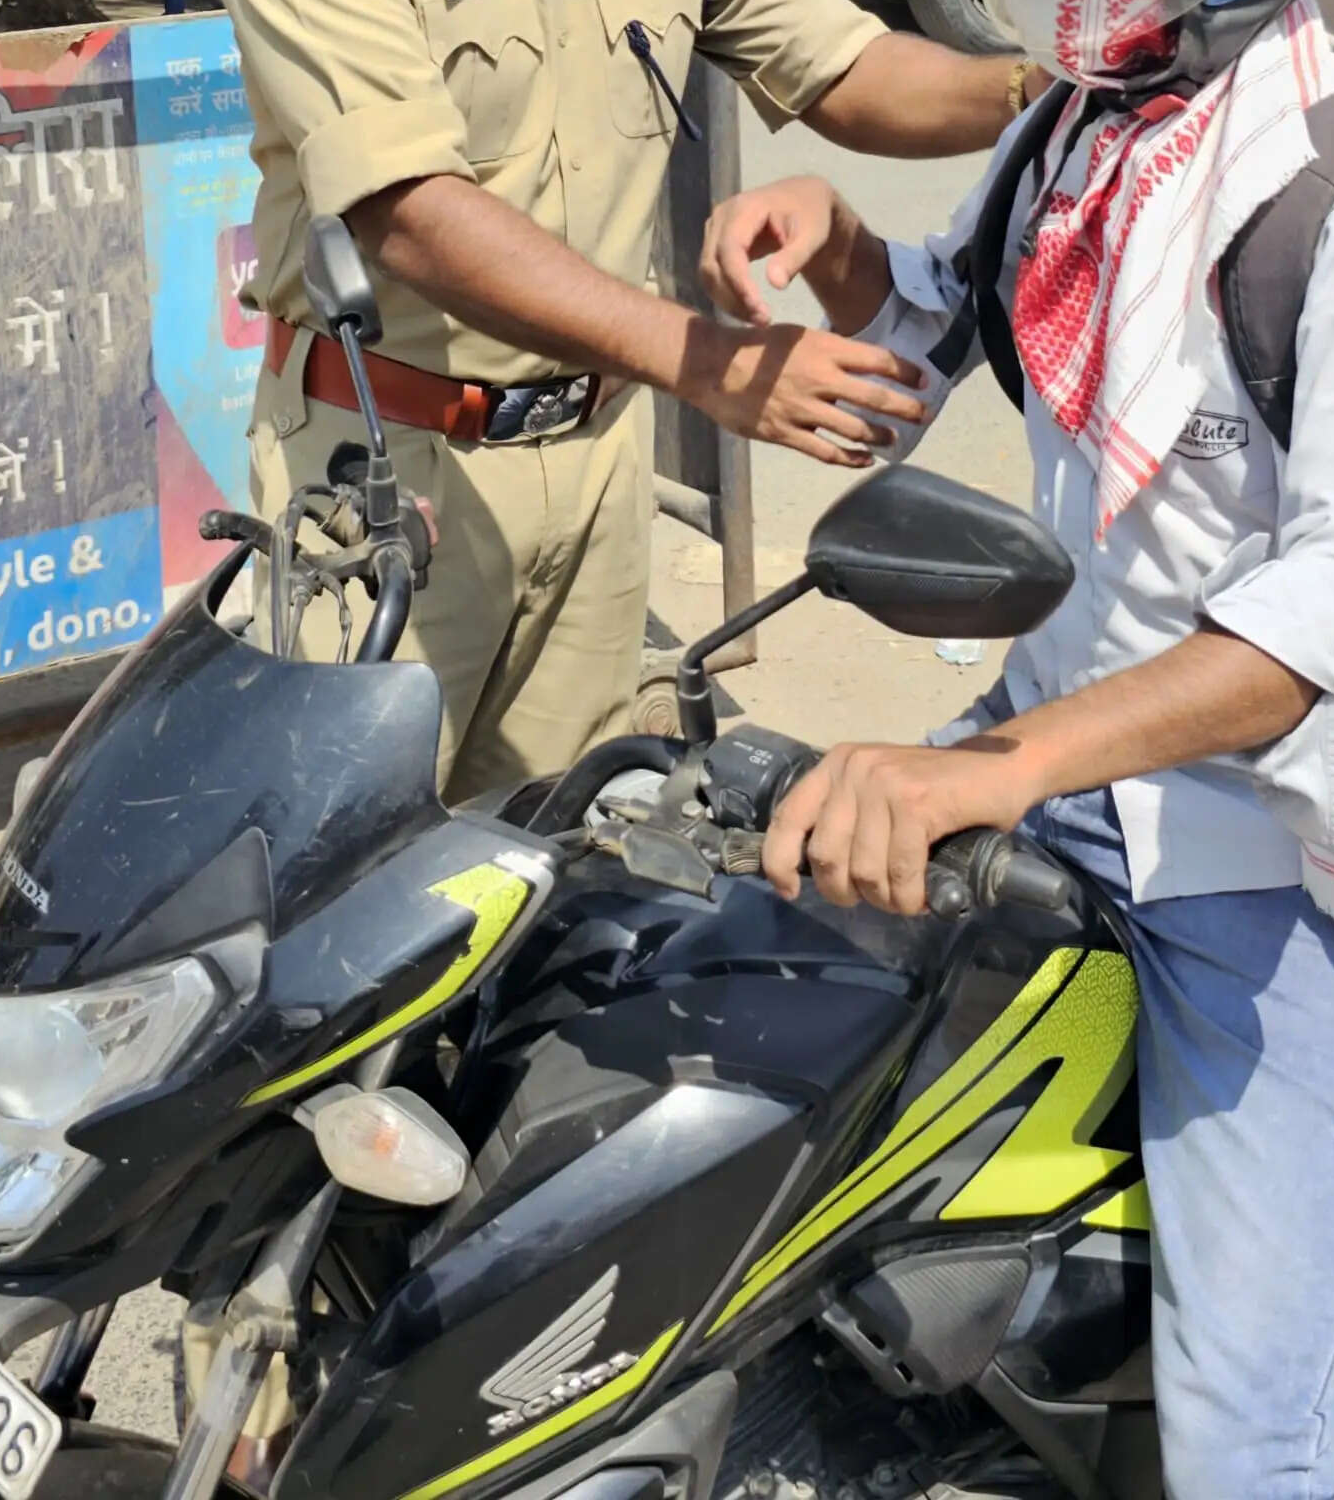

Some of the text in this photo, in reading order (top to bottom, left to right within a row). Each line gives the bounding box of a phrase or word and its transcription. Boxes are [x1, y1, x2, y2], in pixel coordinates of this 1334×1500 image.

[231, 259, 259, 298] yo
[5, 288, 65, 376] में
[68, 534, 104, 576] &
[26, 598, 153, 653] dono.
[485, 1350, 640, 1437] HONDA
